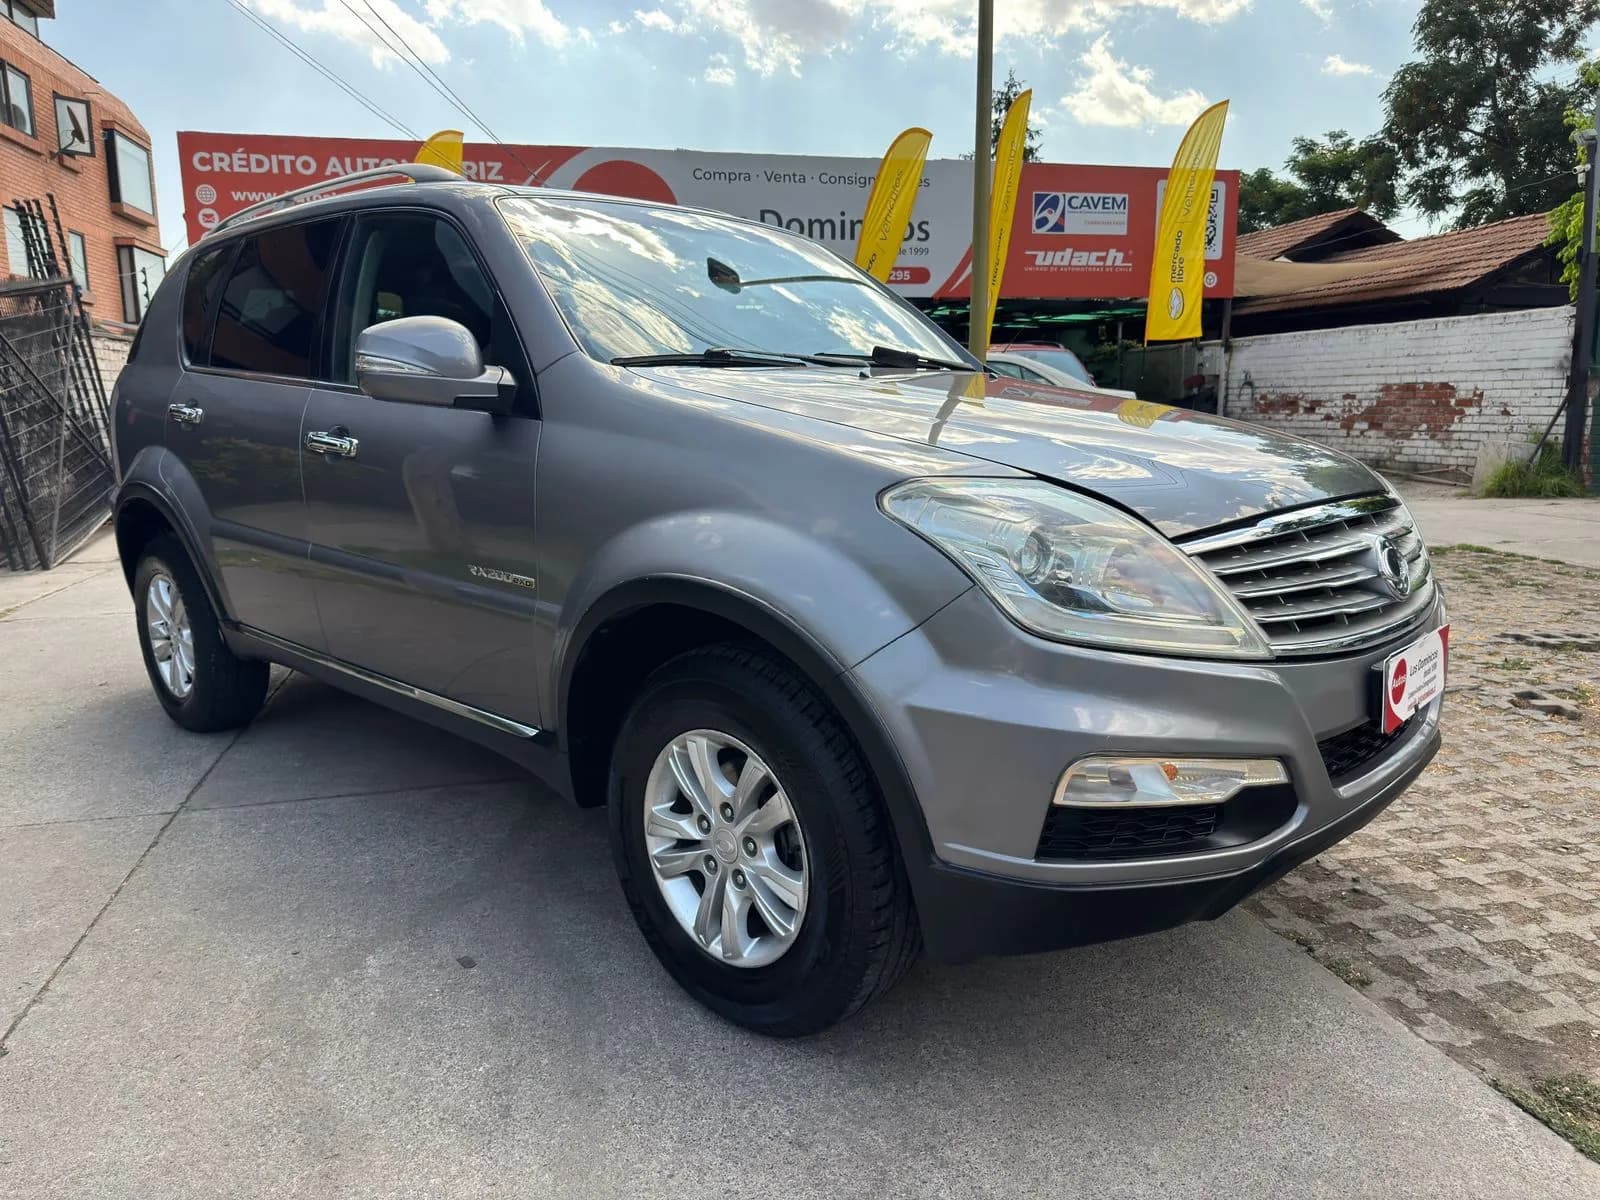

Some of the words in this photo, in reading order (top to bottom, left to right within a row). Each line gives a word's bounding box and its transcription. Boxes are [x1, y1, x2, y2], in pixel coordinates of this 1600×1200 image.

[192, 147, 317, 176] CRÉDITO
[325, 156, 504, 182] AUTRIZ
[692, 167, 752, 185] Compra
[763, 170, 807, 185] Venta
[818, 172, 930, 188] Consignes
[1067, 195, 1127, 211] CAVEM
[759, 208, 931, 242] Dominos
[909, 247, 930, 257] 1999
[1024, 248, 1133, 267] udach
[1170, 229, 1183, 284] mercado
[1176, 256, 1185, 284] libre
